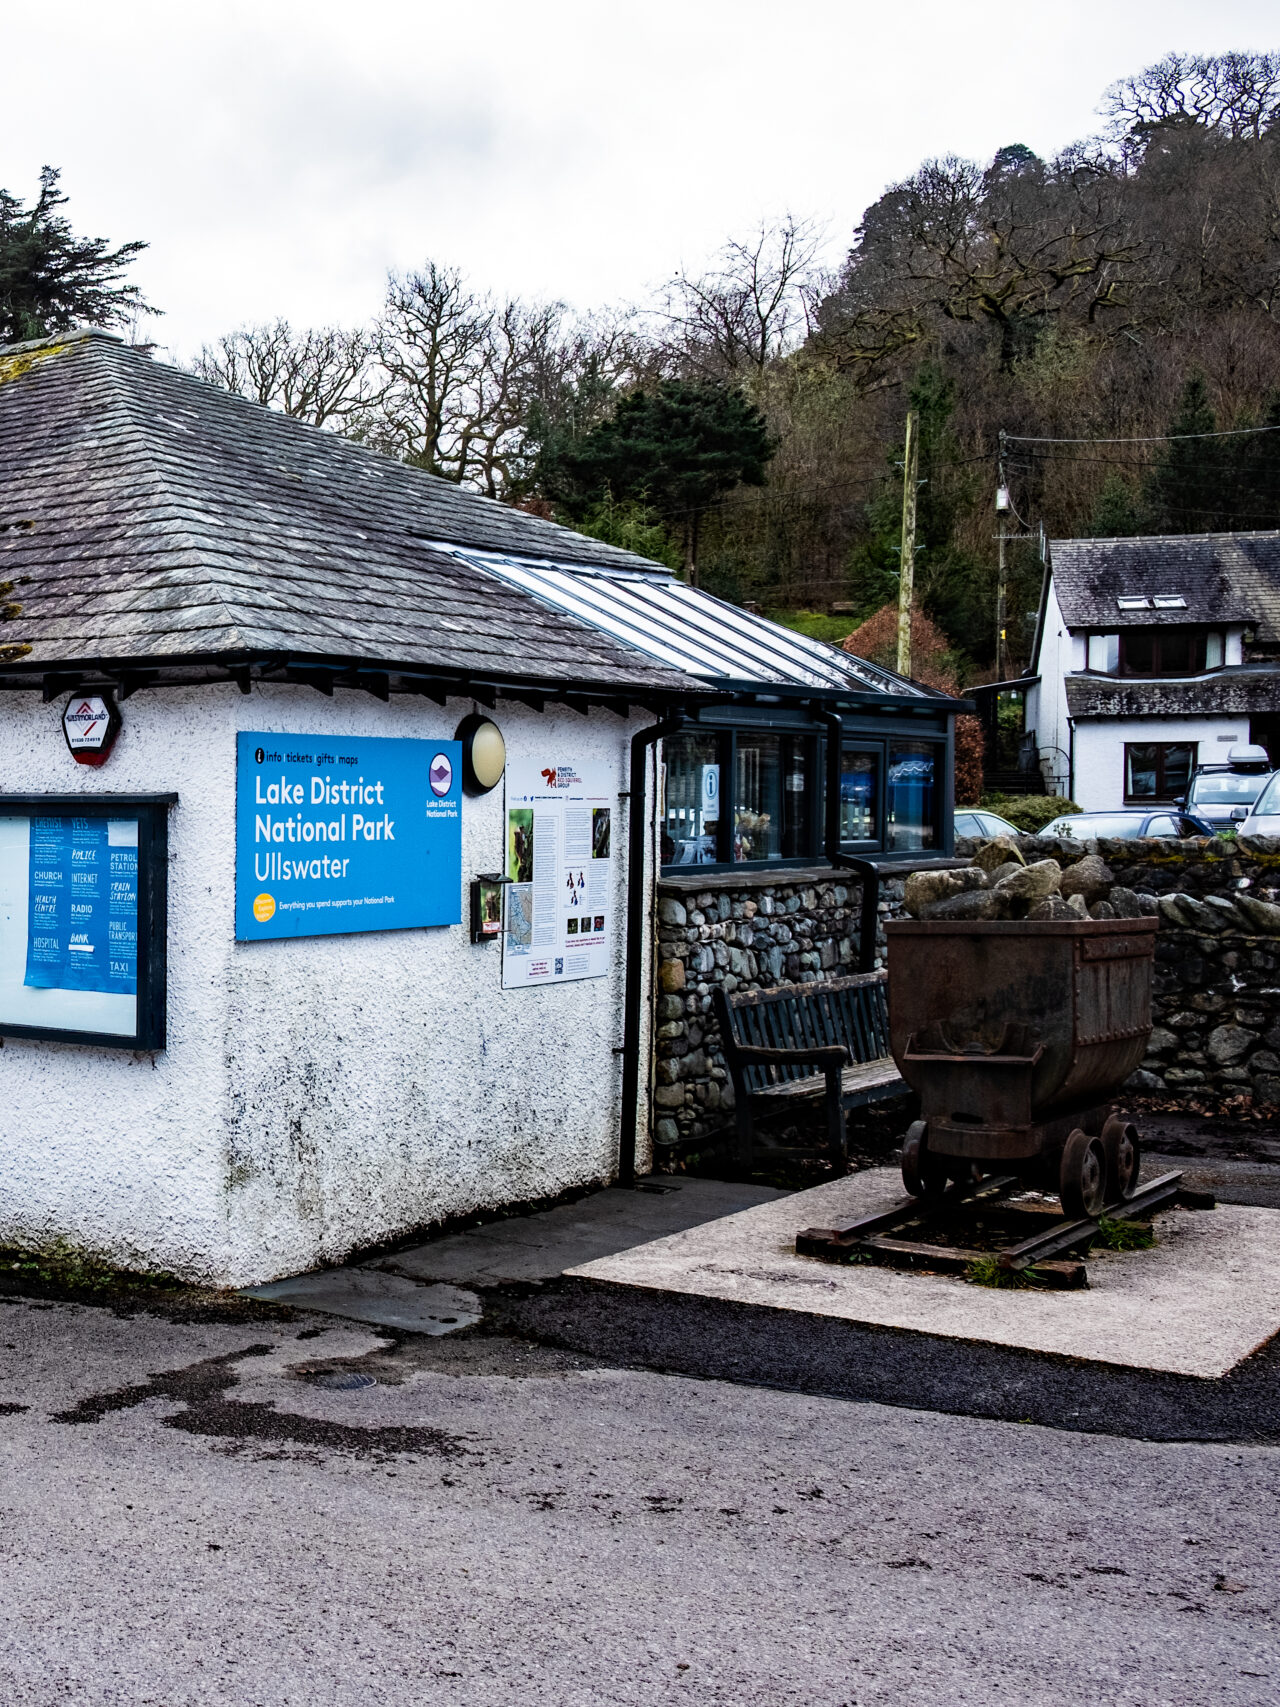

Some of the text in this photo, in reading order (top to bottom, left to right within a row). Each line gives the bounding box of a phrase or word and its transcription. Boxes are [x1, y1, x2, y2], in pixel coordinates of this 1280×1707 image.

[66, 714, 106, 722] WESTMORLAND
[266, 751, 358, 767] info tickets gifts maps
[255, 775, 384, 805] Lake District
[426, 800, 457, 808] Lake District
[426, 810, 458, 818] National Park
[72, 817, 89, 829] VETS
[255, 813, 395, 843] National Park
[71, 849, 97, 860] POLICE
[110, 853, 137, 862] PETROL
[110, 862, 138, 871] STATION
[255, 852, 349, 881] Ullswater
[34, 871, 63, 880] CHURCH
[71, 873, 98, 883] INTERNET
[110, 882, 131, 892] TRAIN
[34, 894, 57, 904] HEALTH
[109, 891, 136, 902] STATION
[34, 904, 57, 913] CENTRE
[279, 895, 395, 912] Everything you spend supports your National Park
[71, 904, 93, 914] RADIO
[109, 921, 127, 931] PUBLIC
[33, 937, 60, 949] HOSPITAL
[70, 933, 89, 944] BANK
[110, 961, 129, 972] TAXI
